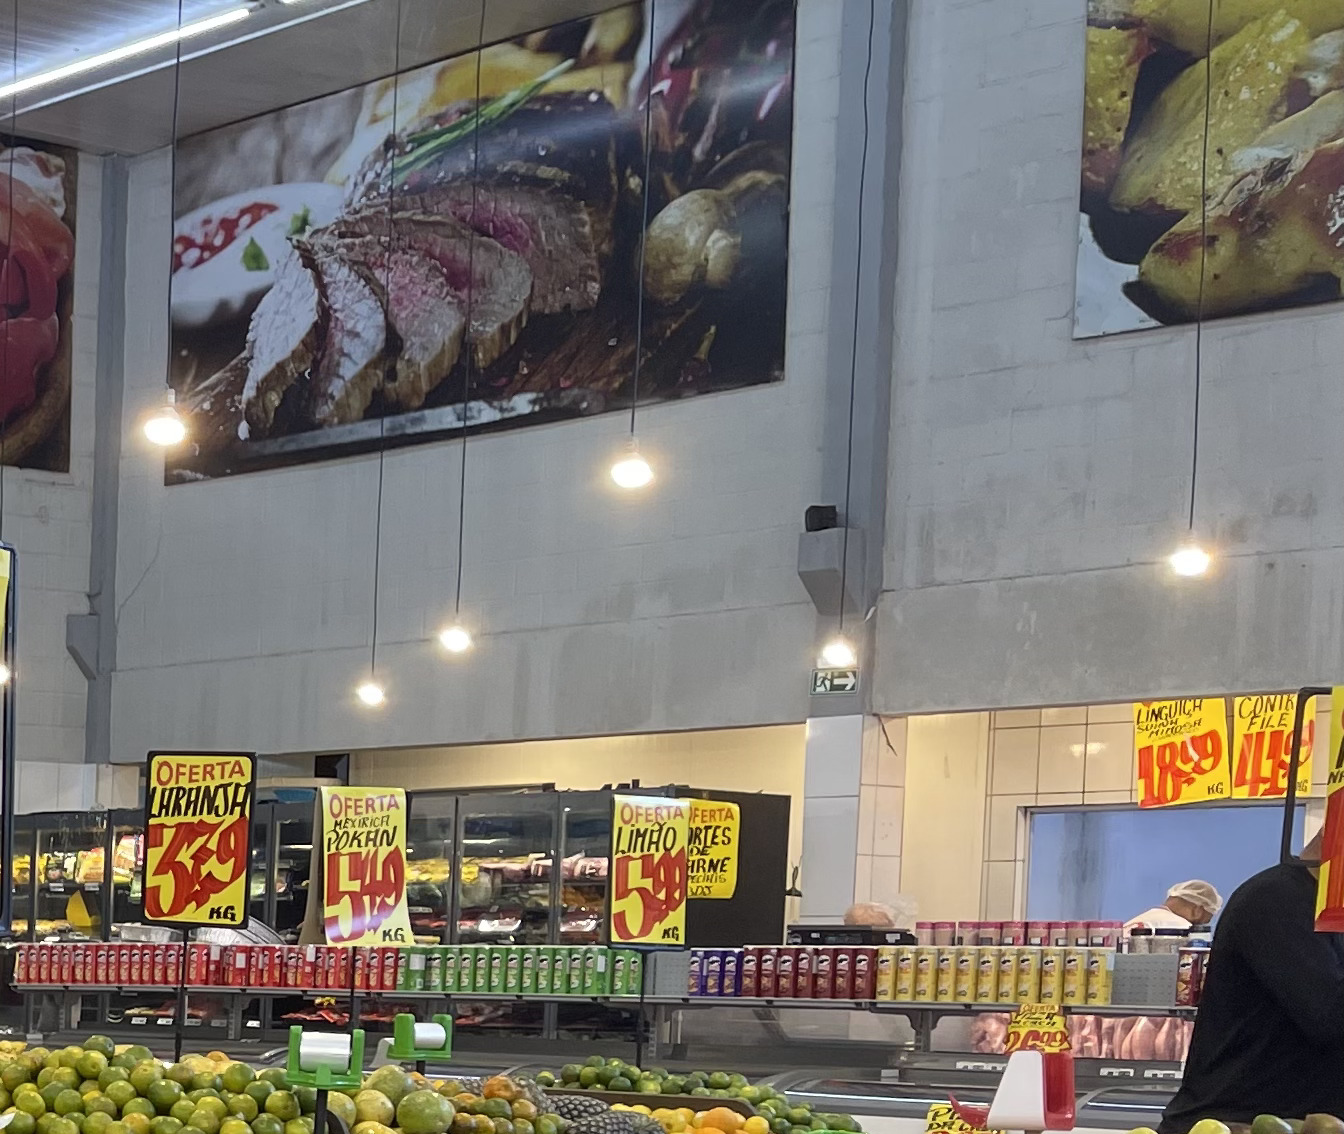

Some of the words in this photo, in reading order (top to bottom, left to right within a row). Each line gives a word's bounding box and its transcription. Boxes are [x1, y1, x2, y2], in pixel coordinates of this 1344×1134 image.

[1239, 694, 1295, 719] CONTR
[157, 760, 245, 786] OFERTA
[151, 782, 252, 818] LARANJA
[1207, 781, 1223, 795] KG
[329, 793, 400, 819] OFERTA
[621, 802, 684, 824] OFERTA
[326, 825, 397, 853] POKAN
[615, 821, 677, 855] LIMÃO
[688, 857, 731, 873] ARNE
[208, 906, 237, 922] KG
[382, 927, 405, 943] KG
